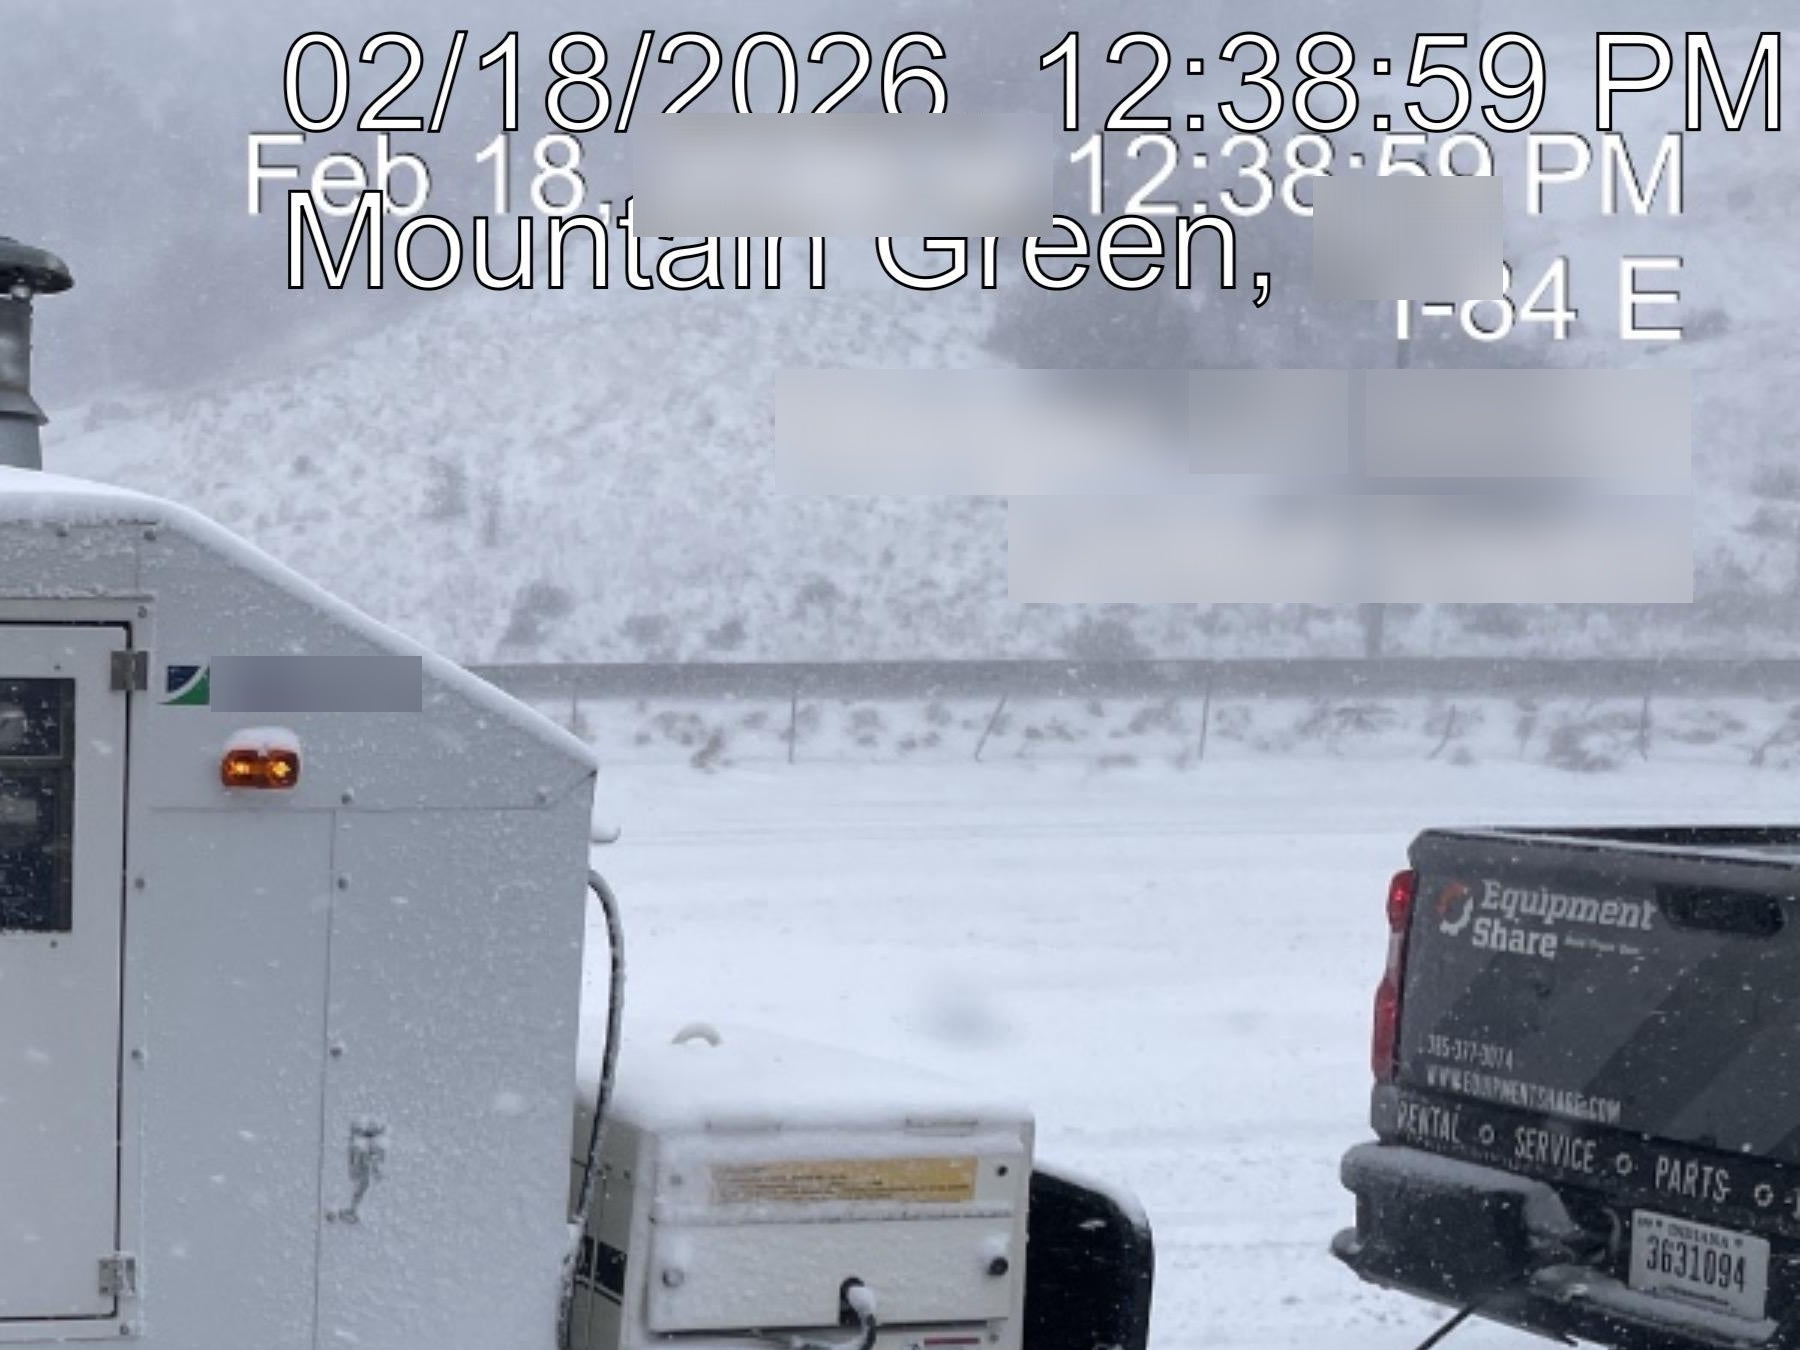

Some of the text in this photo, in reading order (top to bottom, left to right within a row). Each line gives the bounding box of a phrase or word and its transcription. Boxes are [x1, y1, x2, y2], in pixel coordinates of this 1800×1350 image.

[1480, 878, 1659, 931] Equipment
[1471, 916, 1559, 960] Share
[1396, 1100, 1731, 1204] RENTAL SERVICE PARTS
[1646, 1235, 1747, 1294] 3631094
